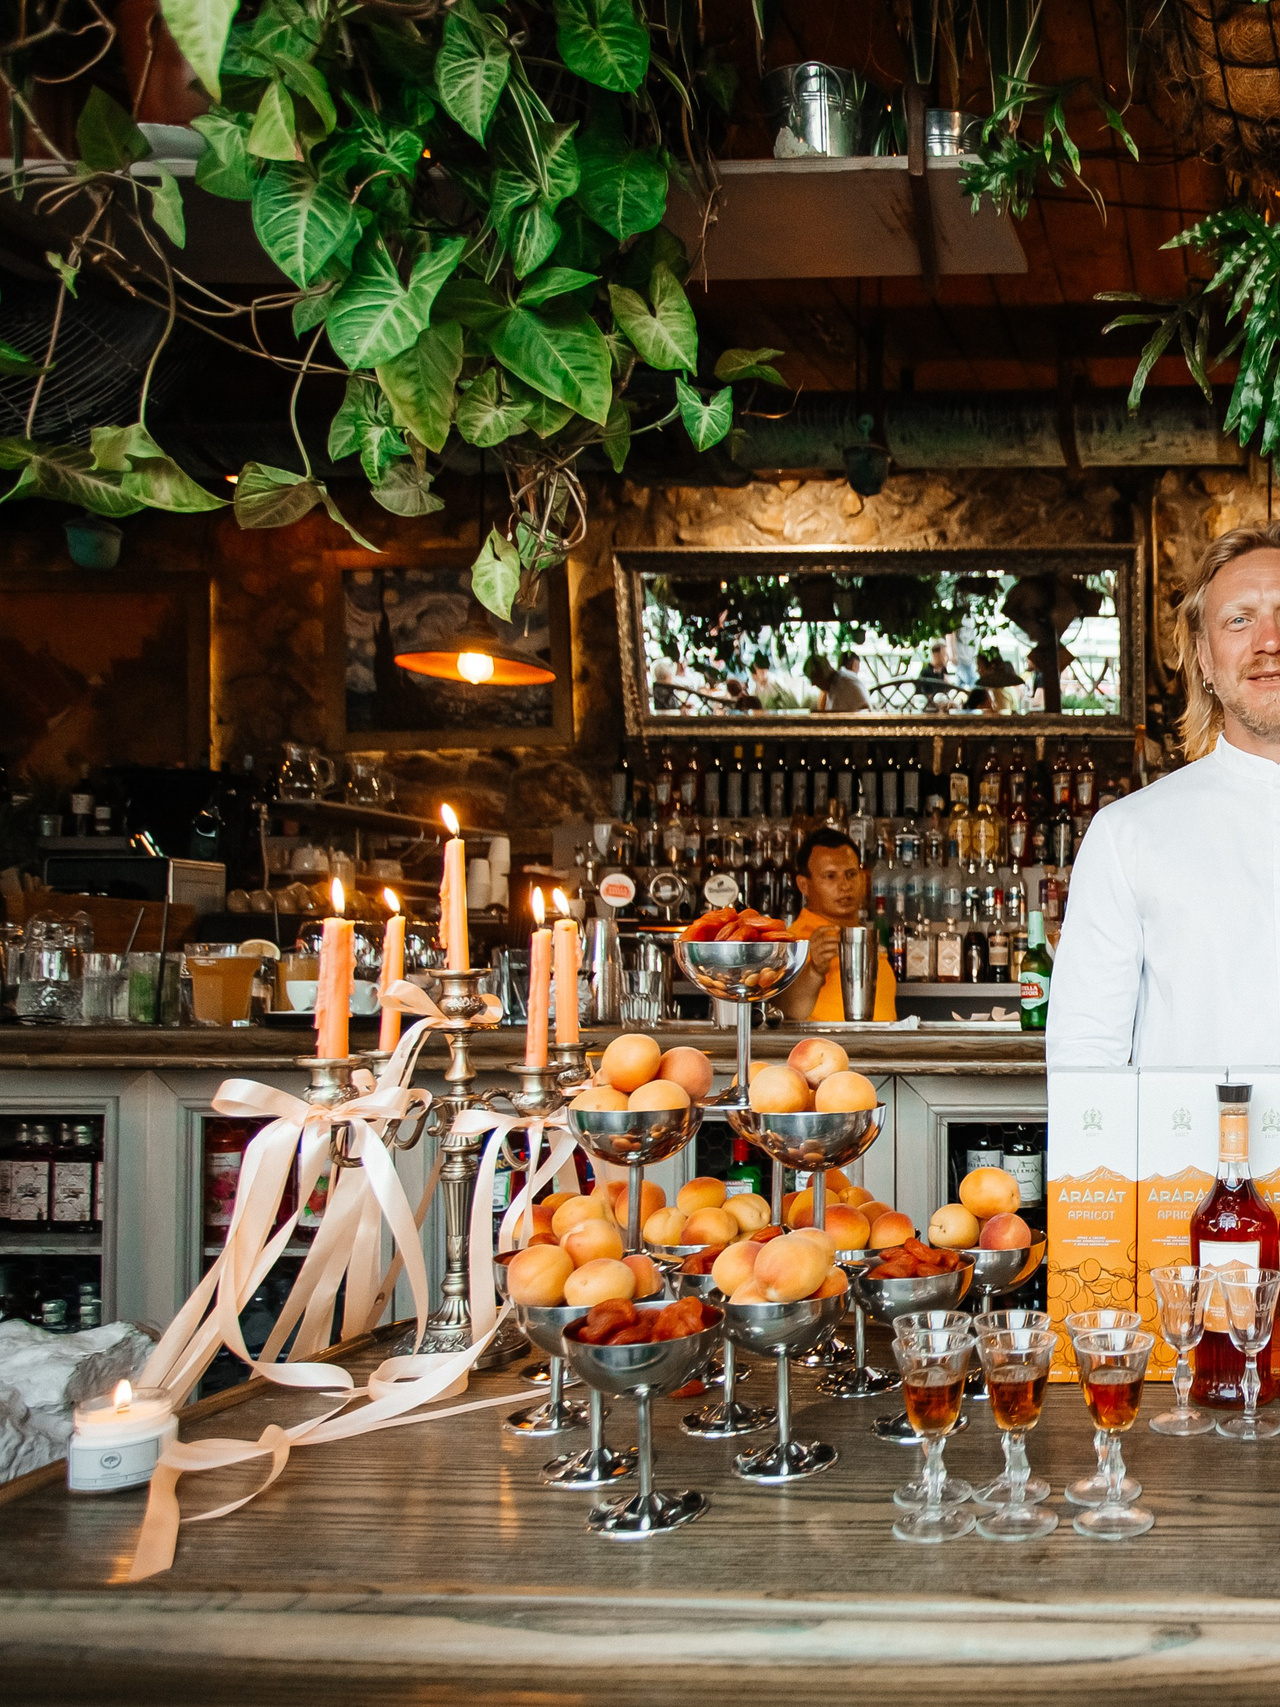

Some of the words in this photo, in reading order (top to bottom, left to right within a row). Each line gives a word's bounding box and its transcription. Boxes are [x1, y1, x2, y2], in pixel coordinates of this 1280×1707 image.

[1058, 1187, 1127, 1204] ARARAT
[1147, 1187, 1209, 1204] ARARA
[1068, 1210, 1115, 1221] APRICOT
[1157, 1210, 1191, 1221] APRIC
